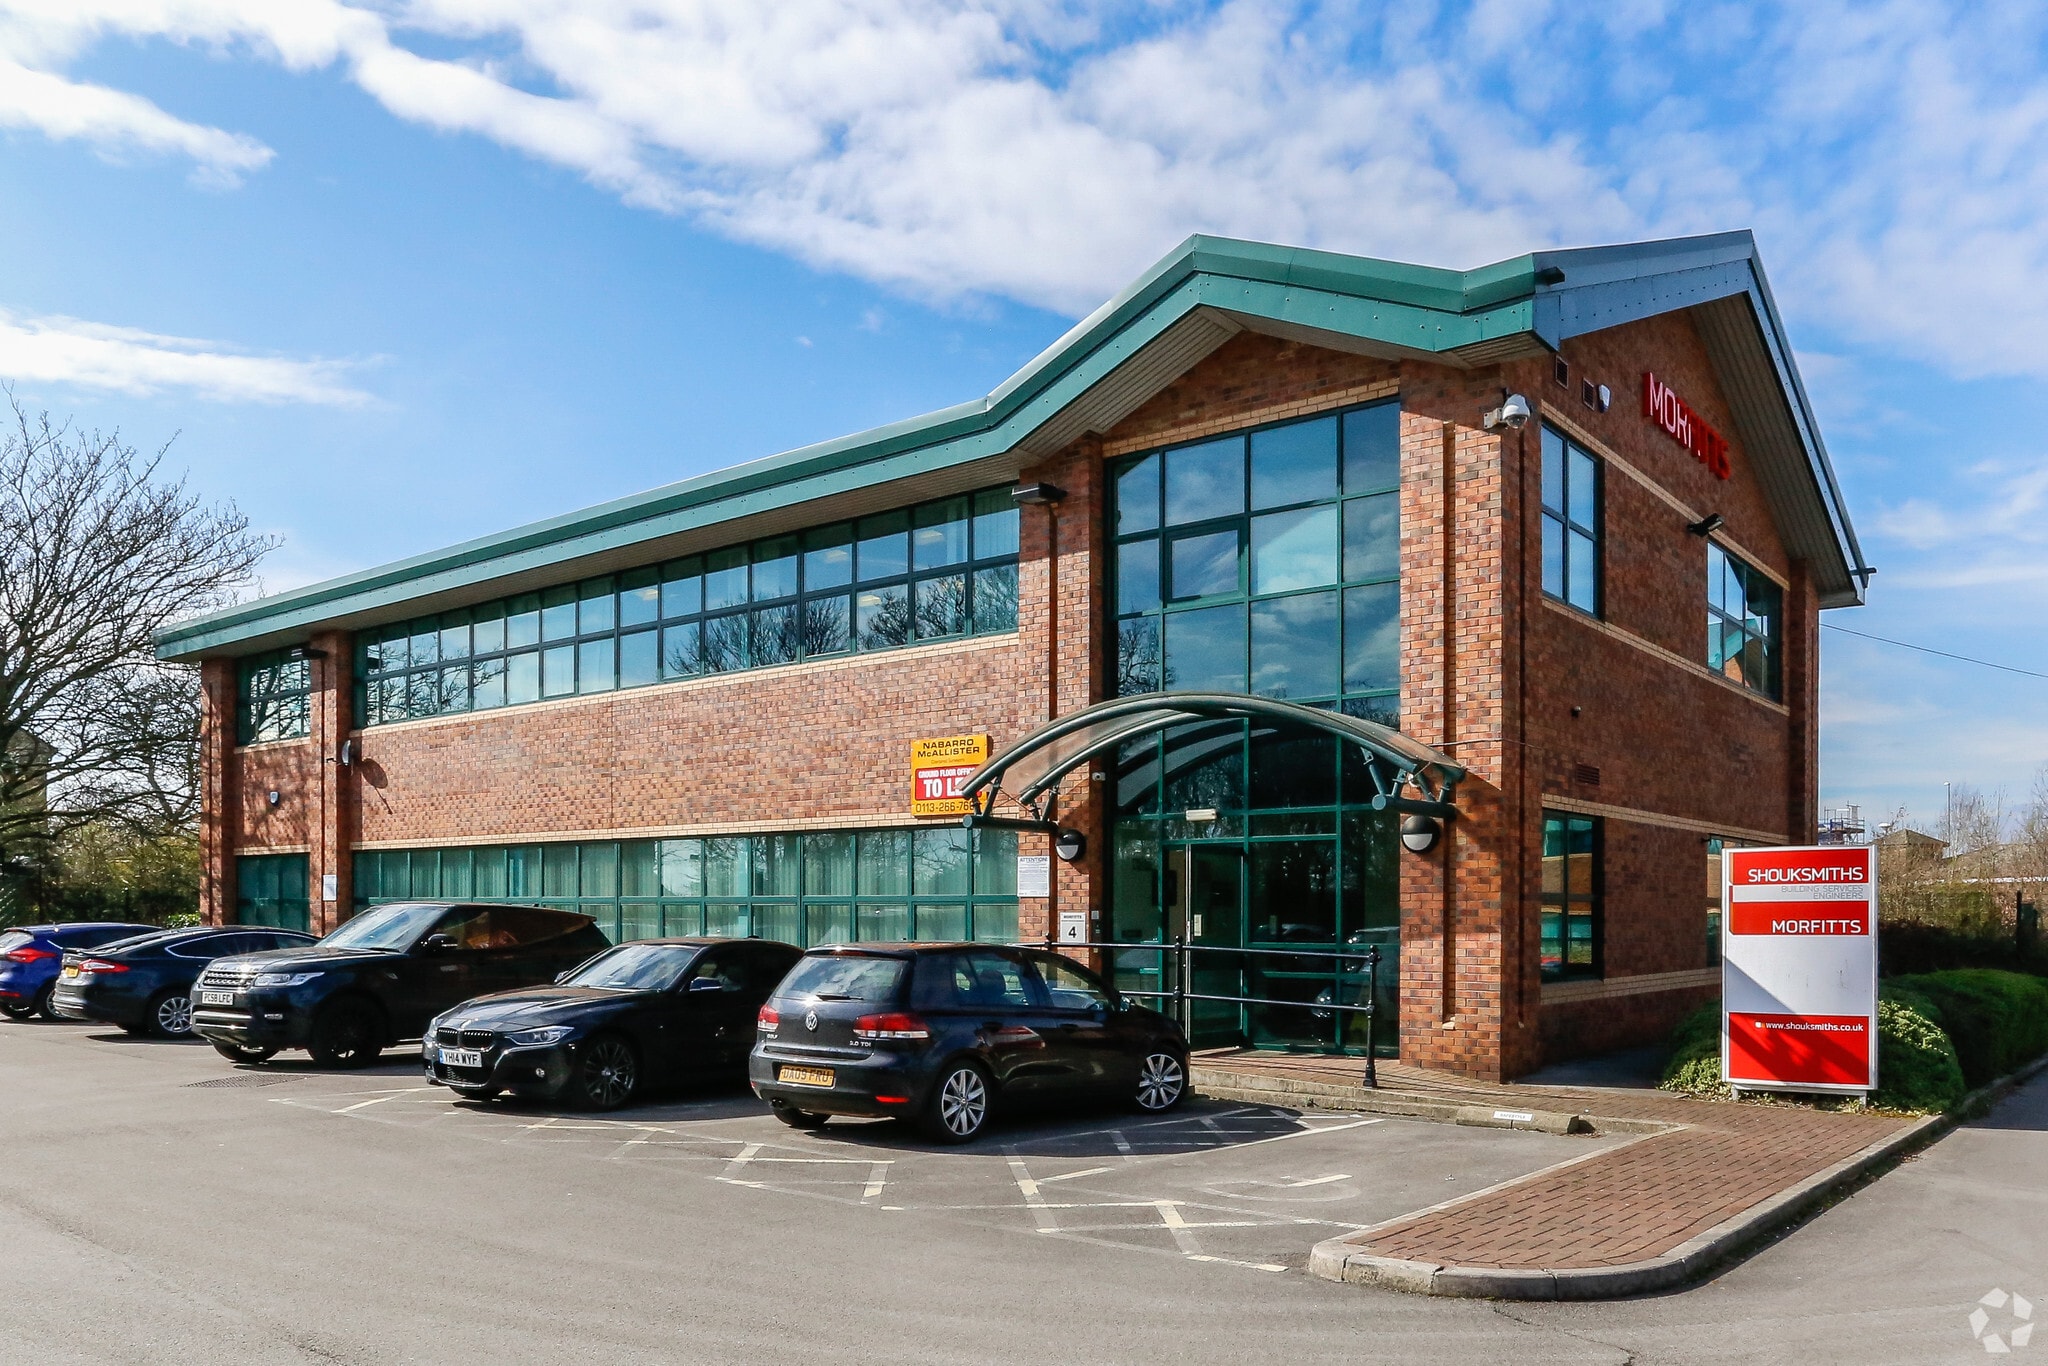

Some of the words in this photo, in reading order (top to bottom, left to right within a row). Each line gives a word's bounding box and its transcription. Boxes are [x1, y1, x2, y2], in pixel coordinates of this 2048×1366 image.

[1642, 371, 1731, 481] MORTTS
[923, 738, 974, 750] NABARRO
[917, 746, 980, 758] McALLISTER
[923, 779, 943, 798] TO
[946, 777, 965, 797] LE
[915, 801, 976, 813] 0113-266-766
[1748, 867, 1864, 882] SHOUKSMITHS
[1781, 885, 1820, 893] BUILDING
[1823, 884, 1864, 892] SERVICES
[1813, 892, 1864, 900] ENGINEERS
[1068, 926, 1077, 938] 4
[1772, 919, 1862, 934] MORFITTS
[1766, 1021, 1864, 1032] www.shouksmiths.co.uk
[808, 1068, 830, 1083] FRU
